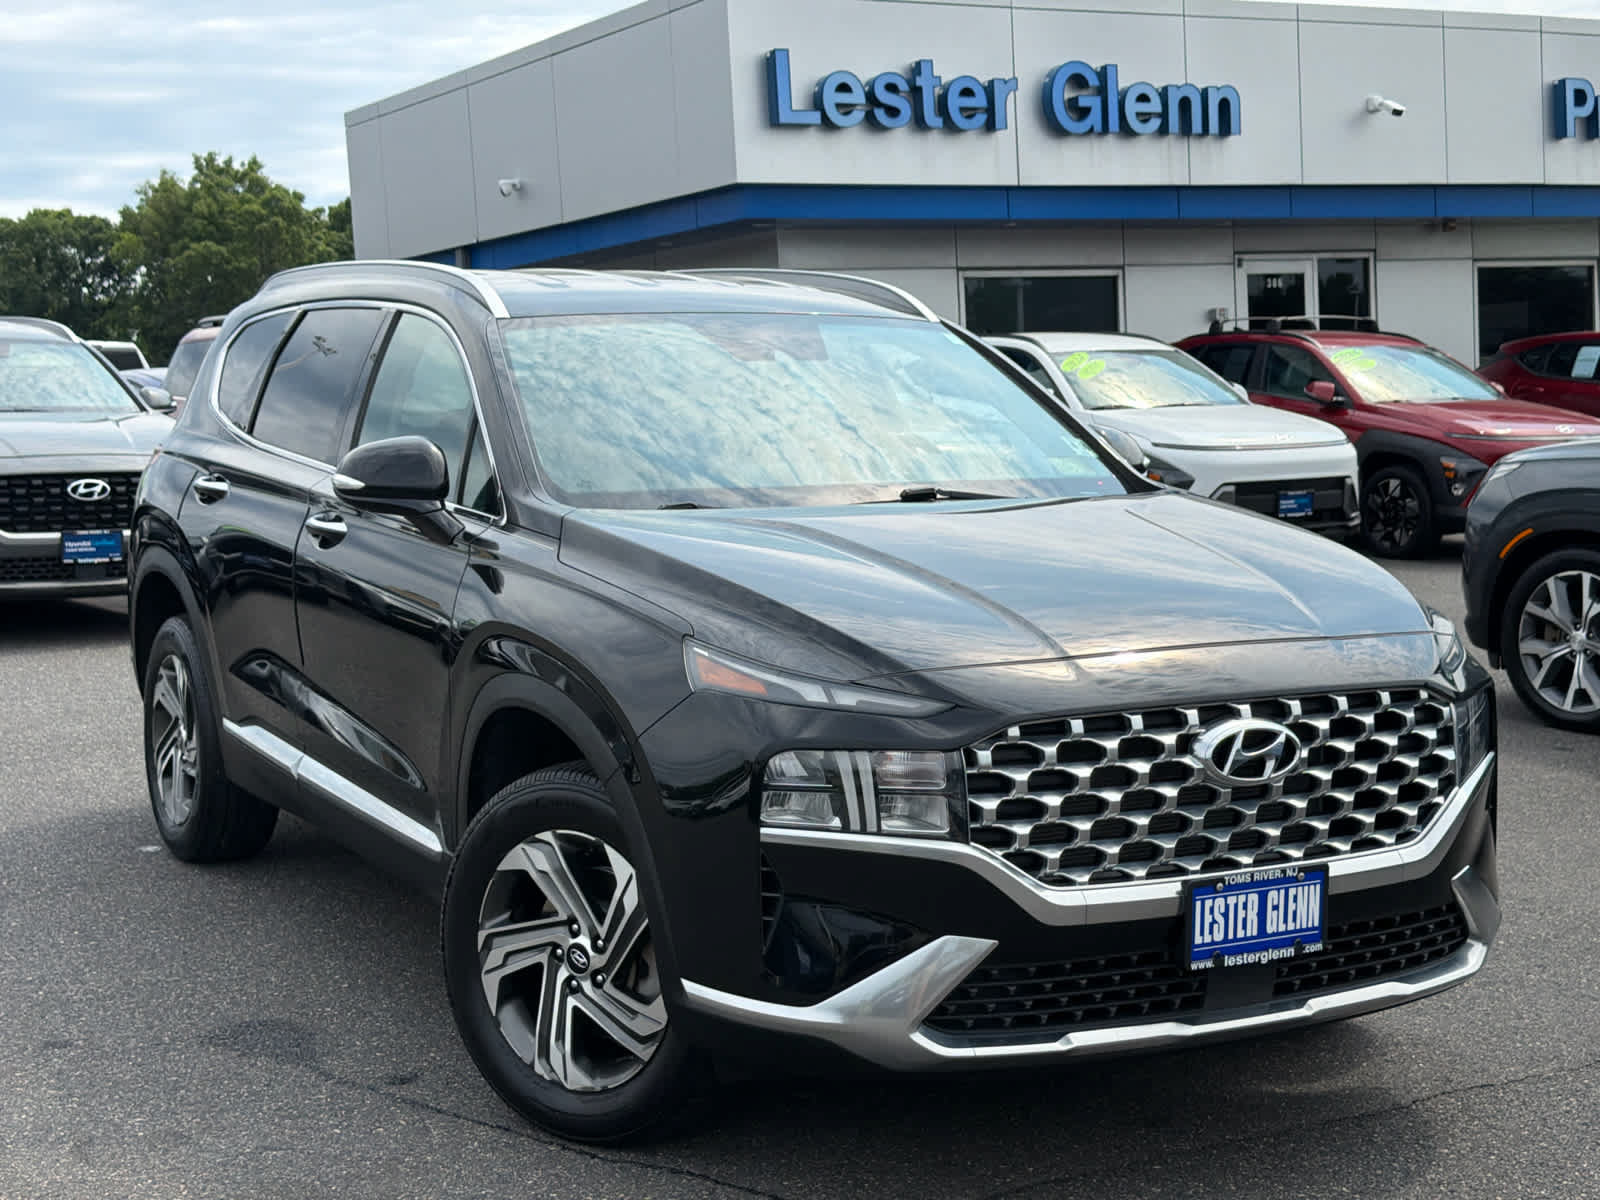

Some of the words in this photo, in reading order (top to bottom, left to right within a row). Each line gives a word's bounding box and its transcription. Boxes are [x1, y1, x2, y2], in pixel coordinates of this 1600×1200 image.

[767, 48, 1018, 131] Lester
[1043, 60, 1242, 137] Glenn
[1556, 77, 1600, 139] P
[1224, 872, 1251, 886] TOMS
[1286, 867, 1298, 878] NJ
[1194, 892, 1259, 945] LESTER
[1265, 884, 1321, 934] GLENN
[1190, 960, 1215, 970] www.
[1224, 947, 1295, 967] lesterglenn
